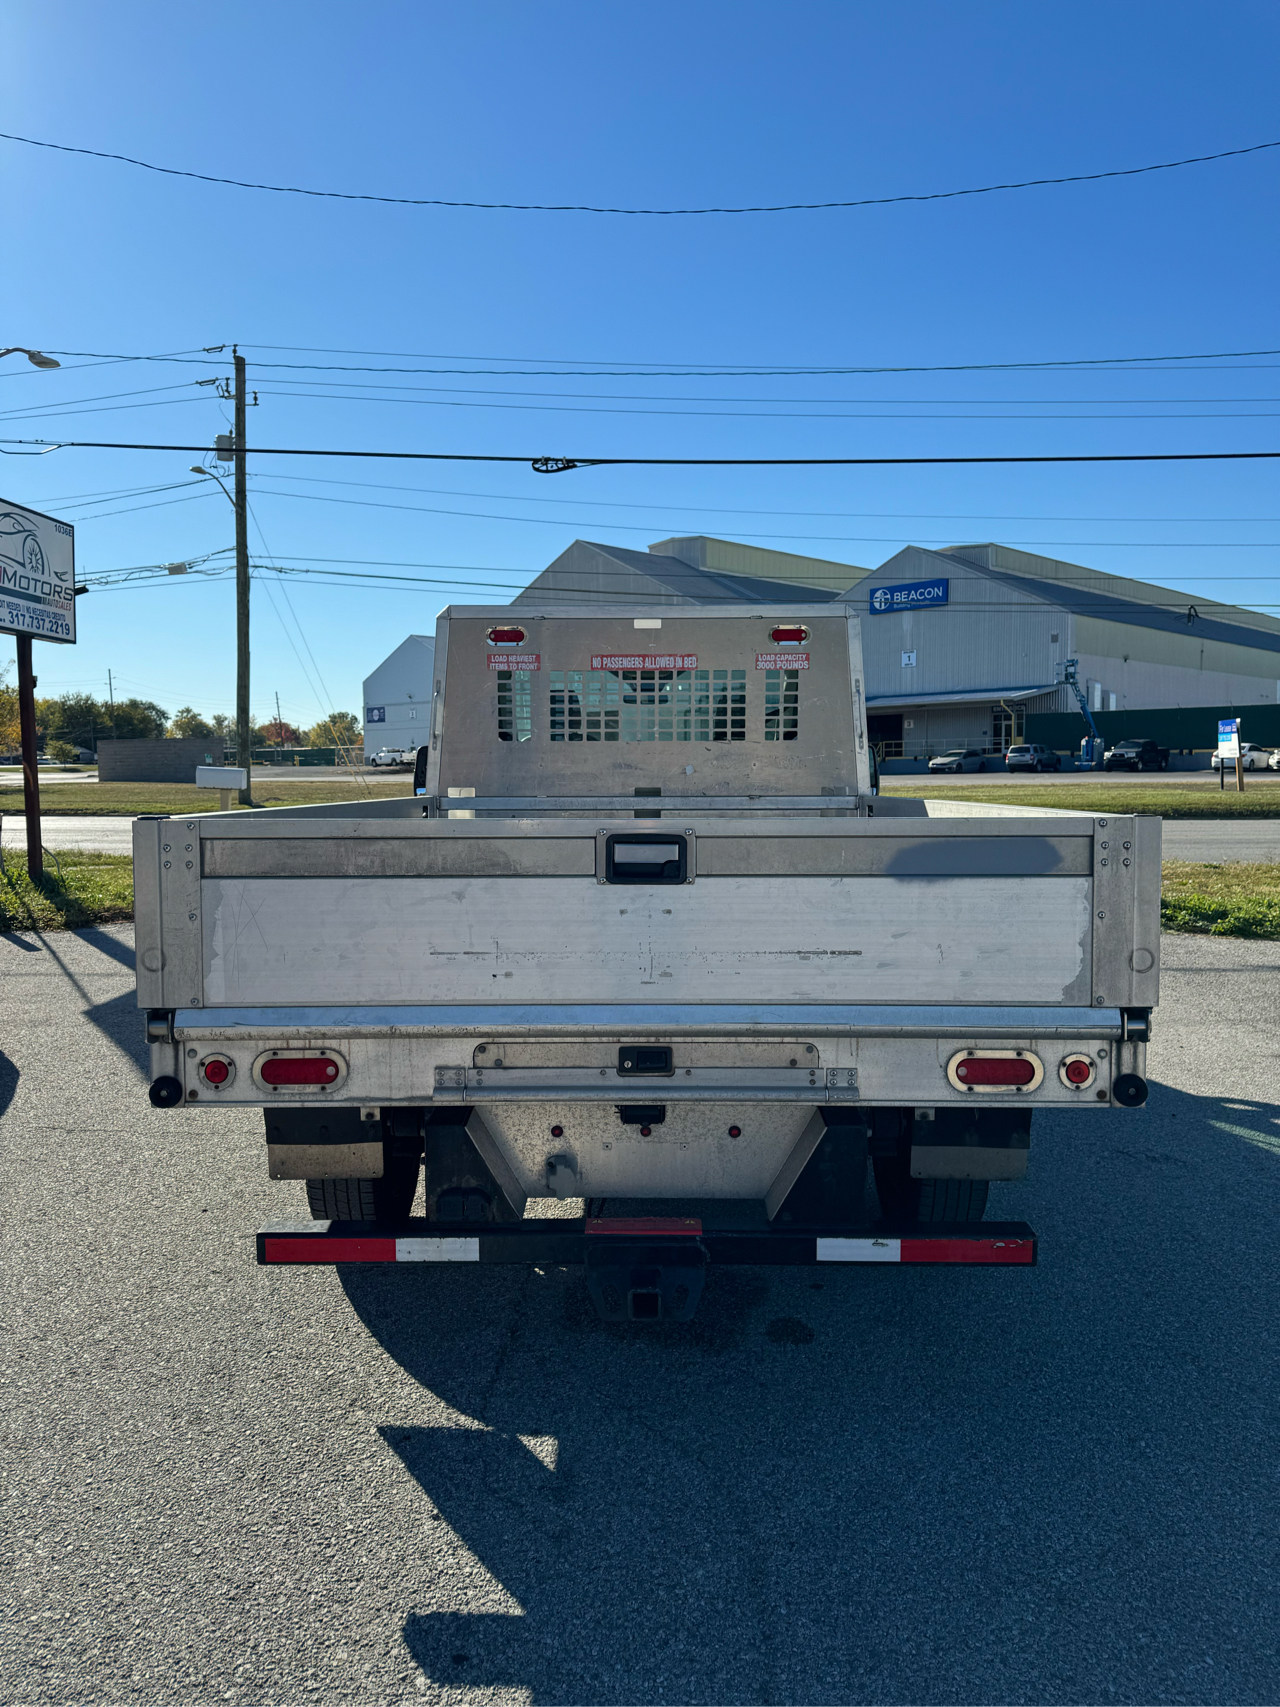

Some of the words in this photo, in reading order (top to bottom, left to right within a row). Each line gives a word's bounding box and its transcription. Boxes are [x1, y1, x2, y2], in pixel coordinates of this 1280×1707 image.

[893, 586, 943, 602] BEACON
[8, 611, 70, 635] 317.737.2219
[592, 657, 602, 668] NO
[603, 657, 644, 668] PASSENGERS
[645, 656, 675, 668] ALLOWED
[676, 657, 683, 668] IN
[684, 657, 697, 668] BED
[756, 661, 775, 669] 3000
[776, 660, 809, 669] POUNDS
